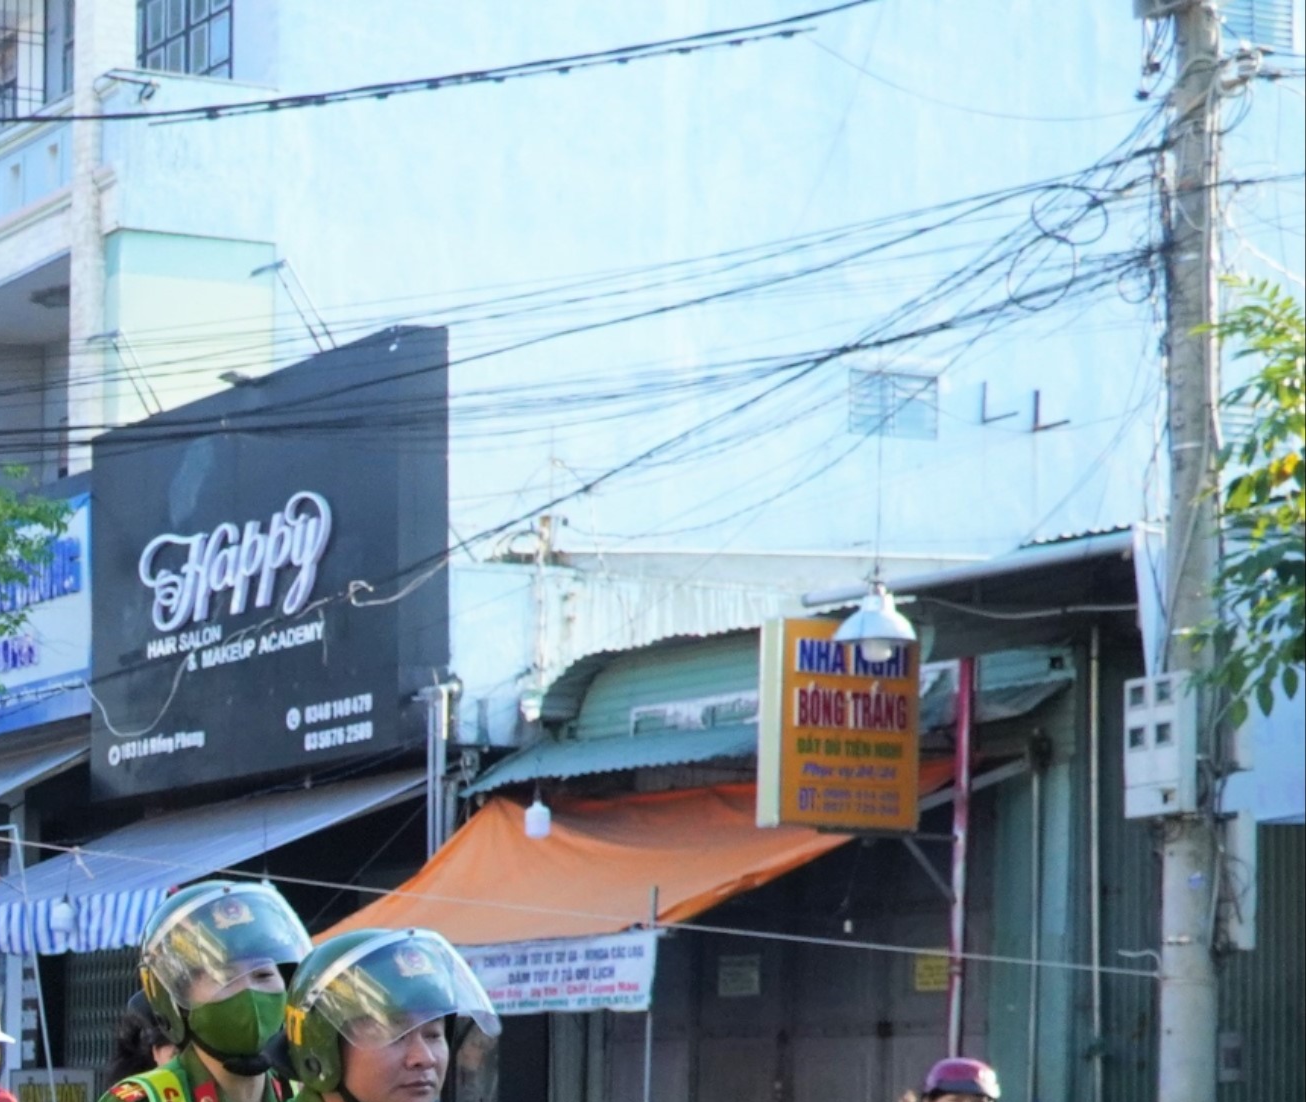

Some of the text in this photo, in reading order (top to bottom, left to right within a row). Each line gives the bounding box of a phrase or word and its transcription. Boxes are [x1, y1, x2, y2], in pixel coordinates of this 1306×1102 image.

[138, 491, 332, 632] Happy
[147, 624, 222, 660] HAIR SALON
[201, 638, 256, 669] MAKEUP
[259, 620, 325, 654] ACADEMY
